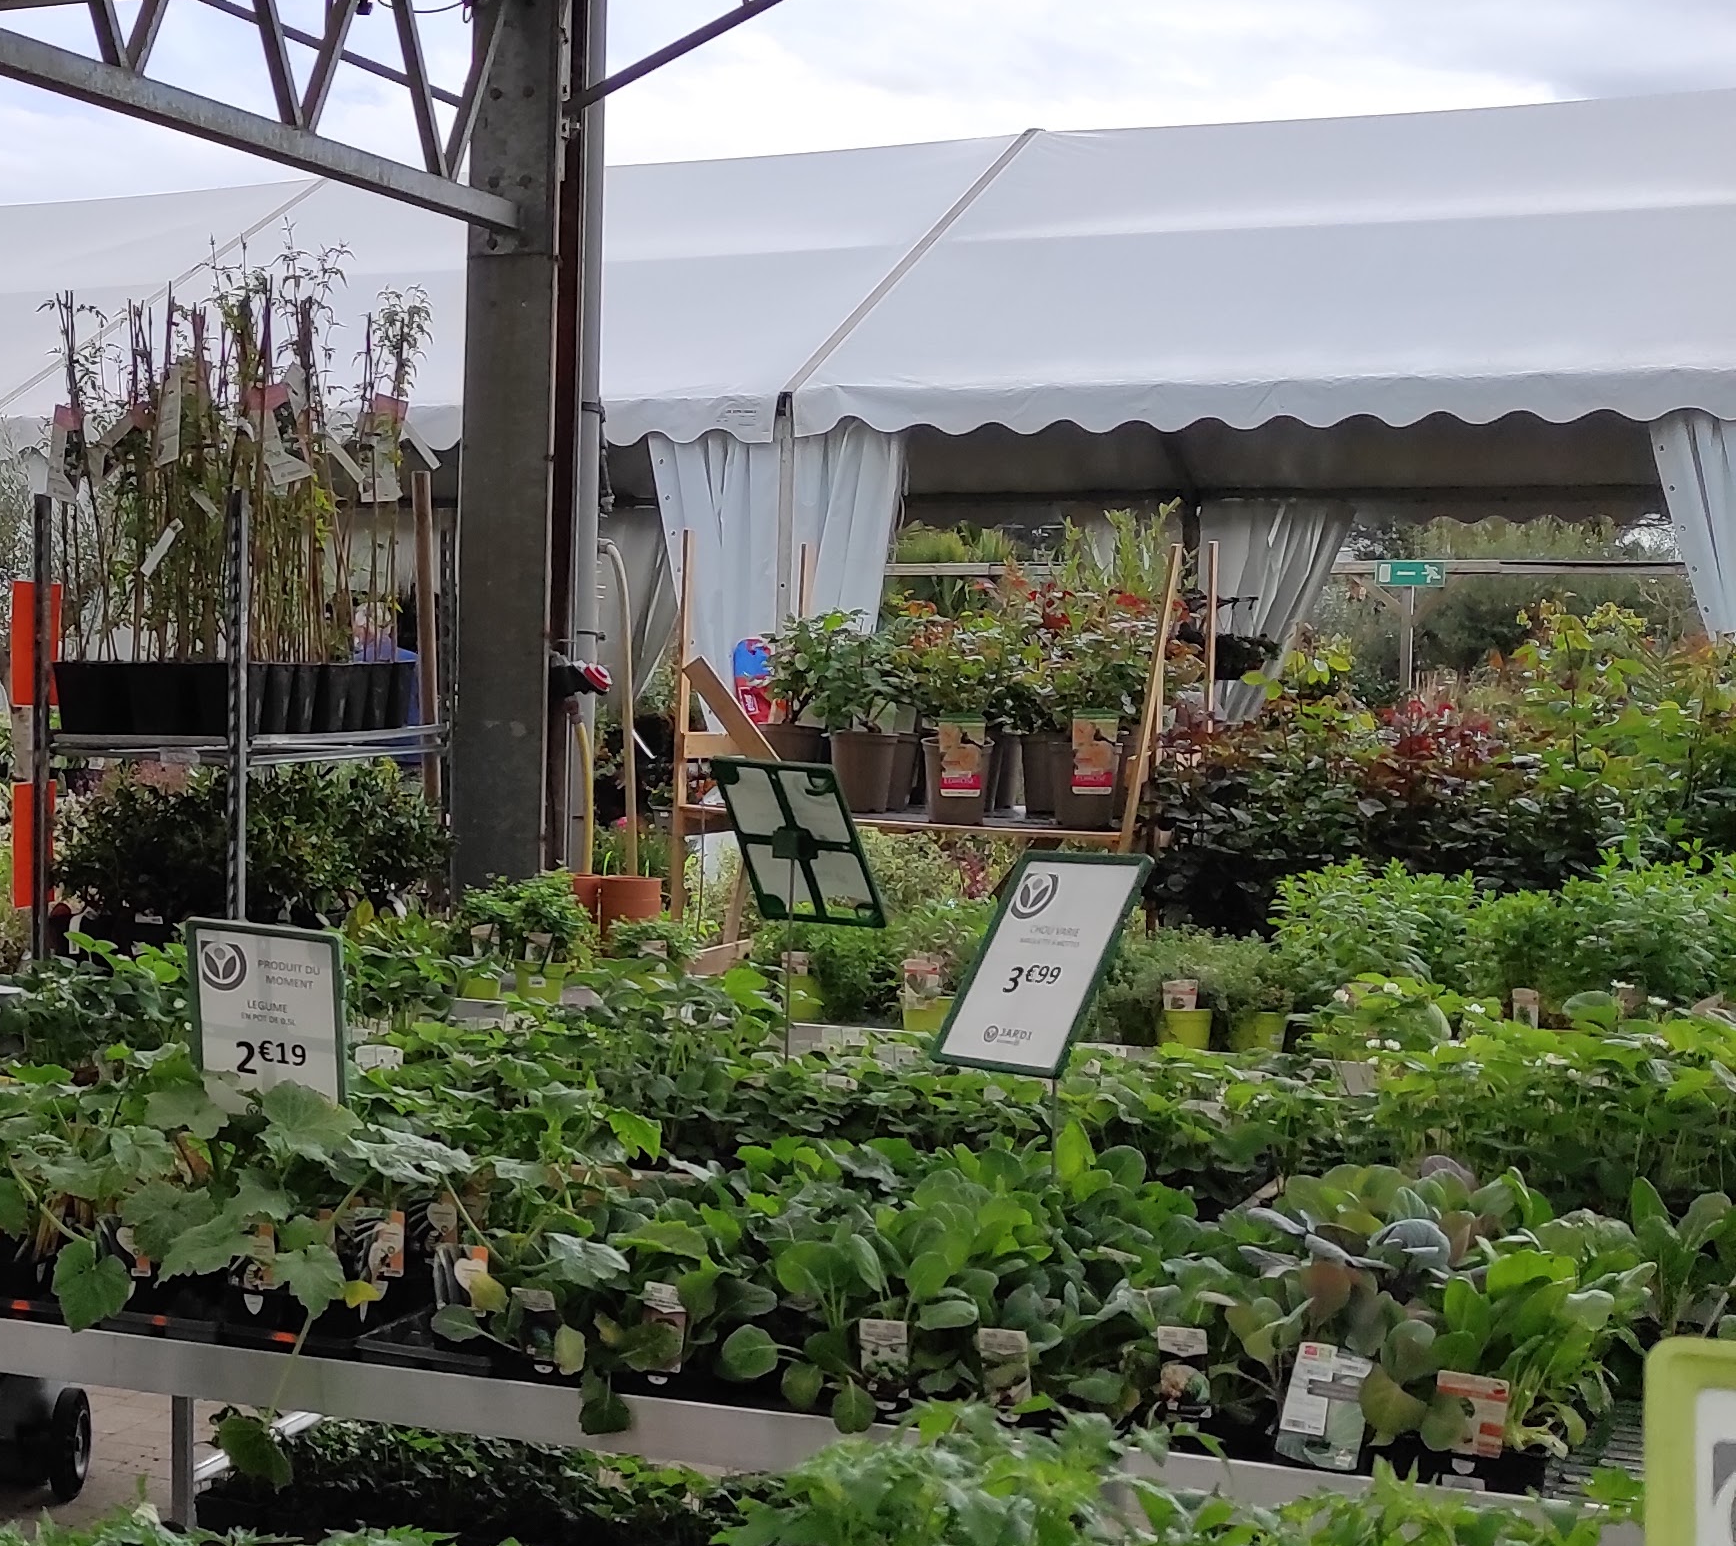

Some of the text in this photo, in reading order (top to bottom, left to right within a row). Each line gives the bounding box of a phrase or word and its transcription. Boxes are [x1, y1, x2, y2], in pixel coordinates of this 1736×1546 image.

[257, 959, 320, 976] PRODUIT DU
[266, 975, 314, 990] MOMENT
[1002, 963, 1061, 993] 3€99
[247, 999, 288, 1014] LEGUME
[253, 1013, 267, 1022] POT
[269, 1015, 279, 1024] DE
[236, 1040, 307, 1075] 2€19
